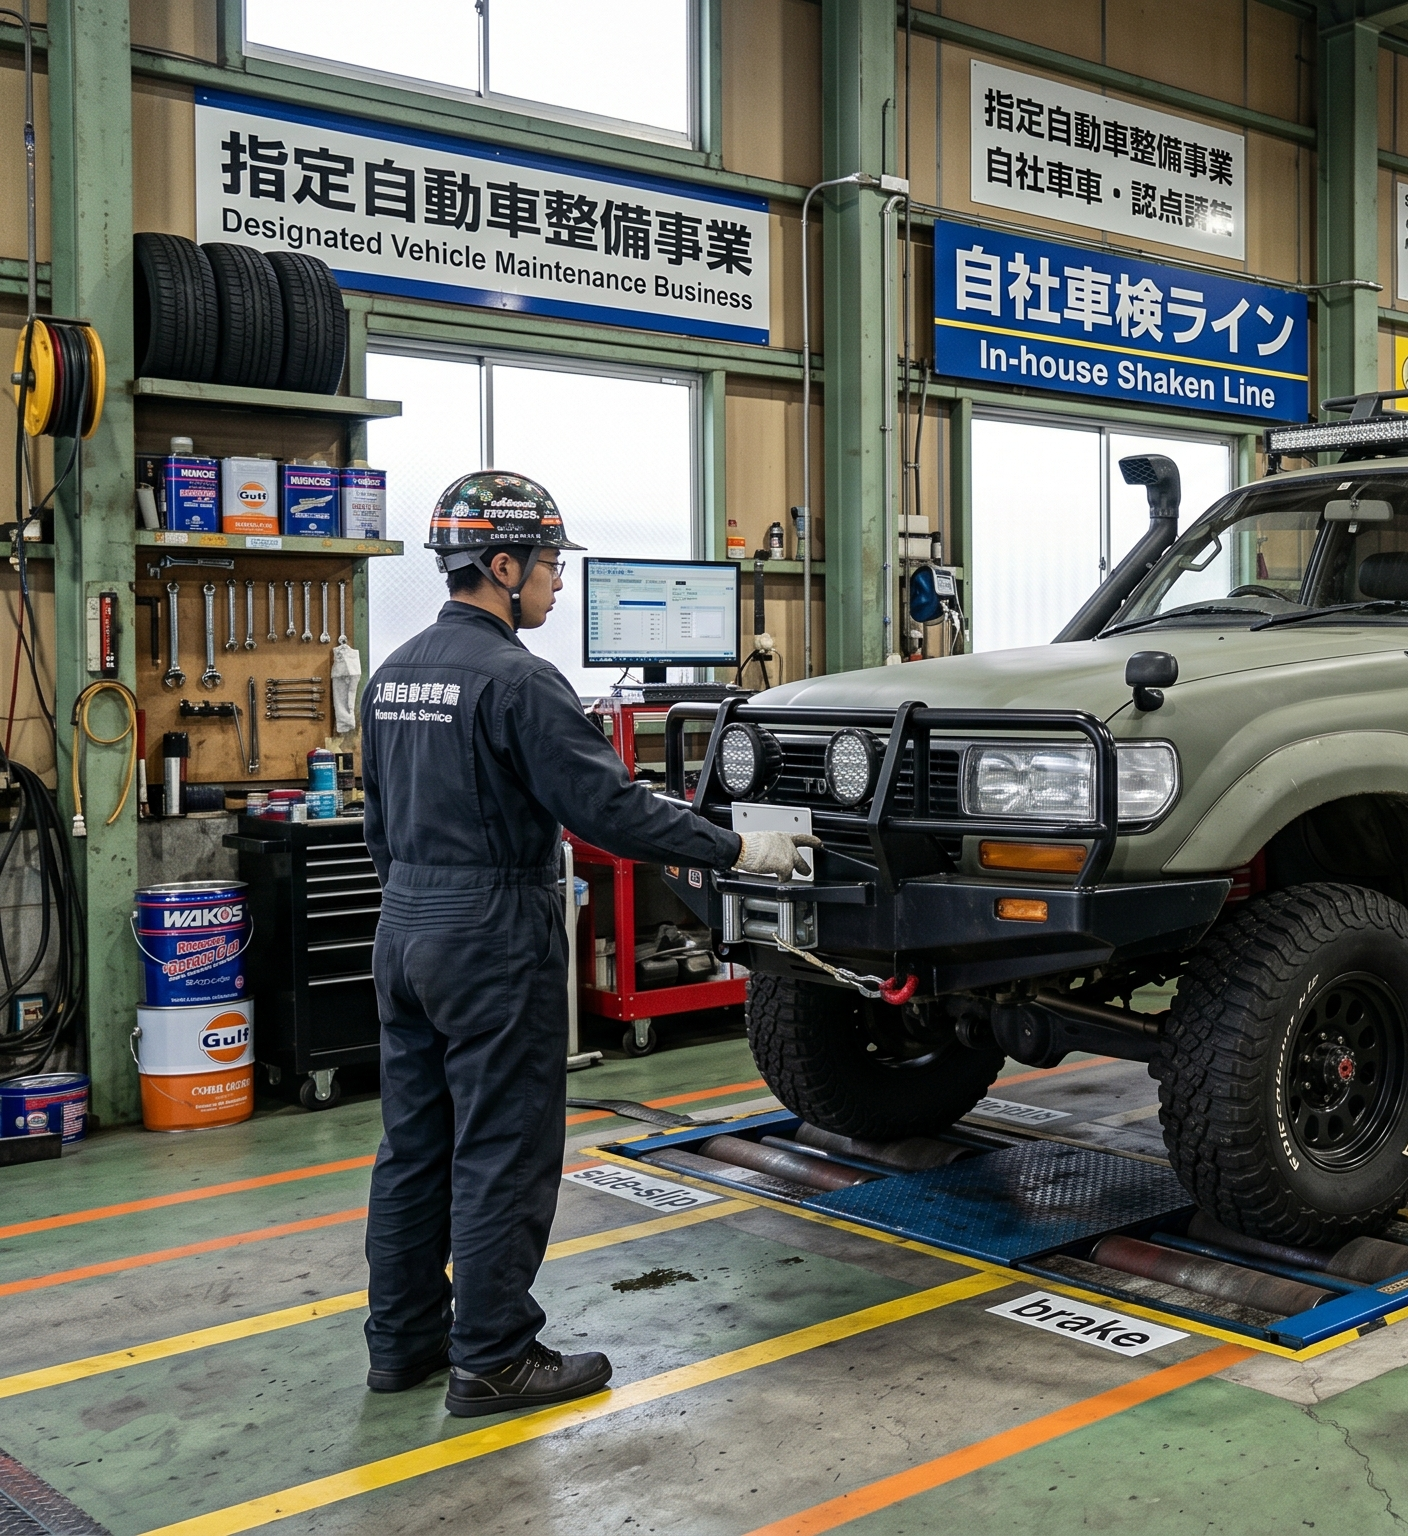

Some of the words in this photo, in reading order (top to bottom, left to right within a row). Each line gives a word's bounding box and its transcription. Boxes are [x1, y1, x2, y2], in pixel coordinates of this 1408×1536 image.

[985, 88, 1233, 186] 指定自動車整備事業
[221, 131, 753, 277] 指定自動車整備事業
[221, 208, 383, 256] Designated
[391, 234, 486, 272] Vehicle
[495, 250, 647, 297] Maintenance
[653, 275, 753, 311] Business
[955, 245, 1295, 358] 自社車検ライン
[979, 339, 1108, 387] In-house
[1116, 360, 1214, 401] Shaken
[1223, 374, 1276, 410] Line
[202, 1027, 250, 1048] Gulf
[1008, 1298, 1151, 1348] brake
